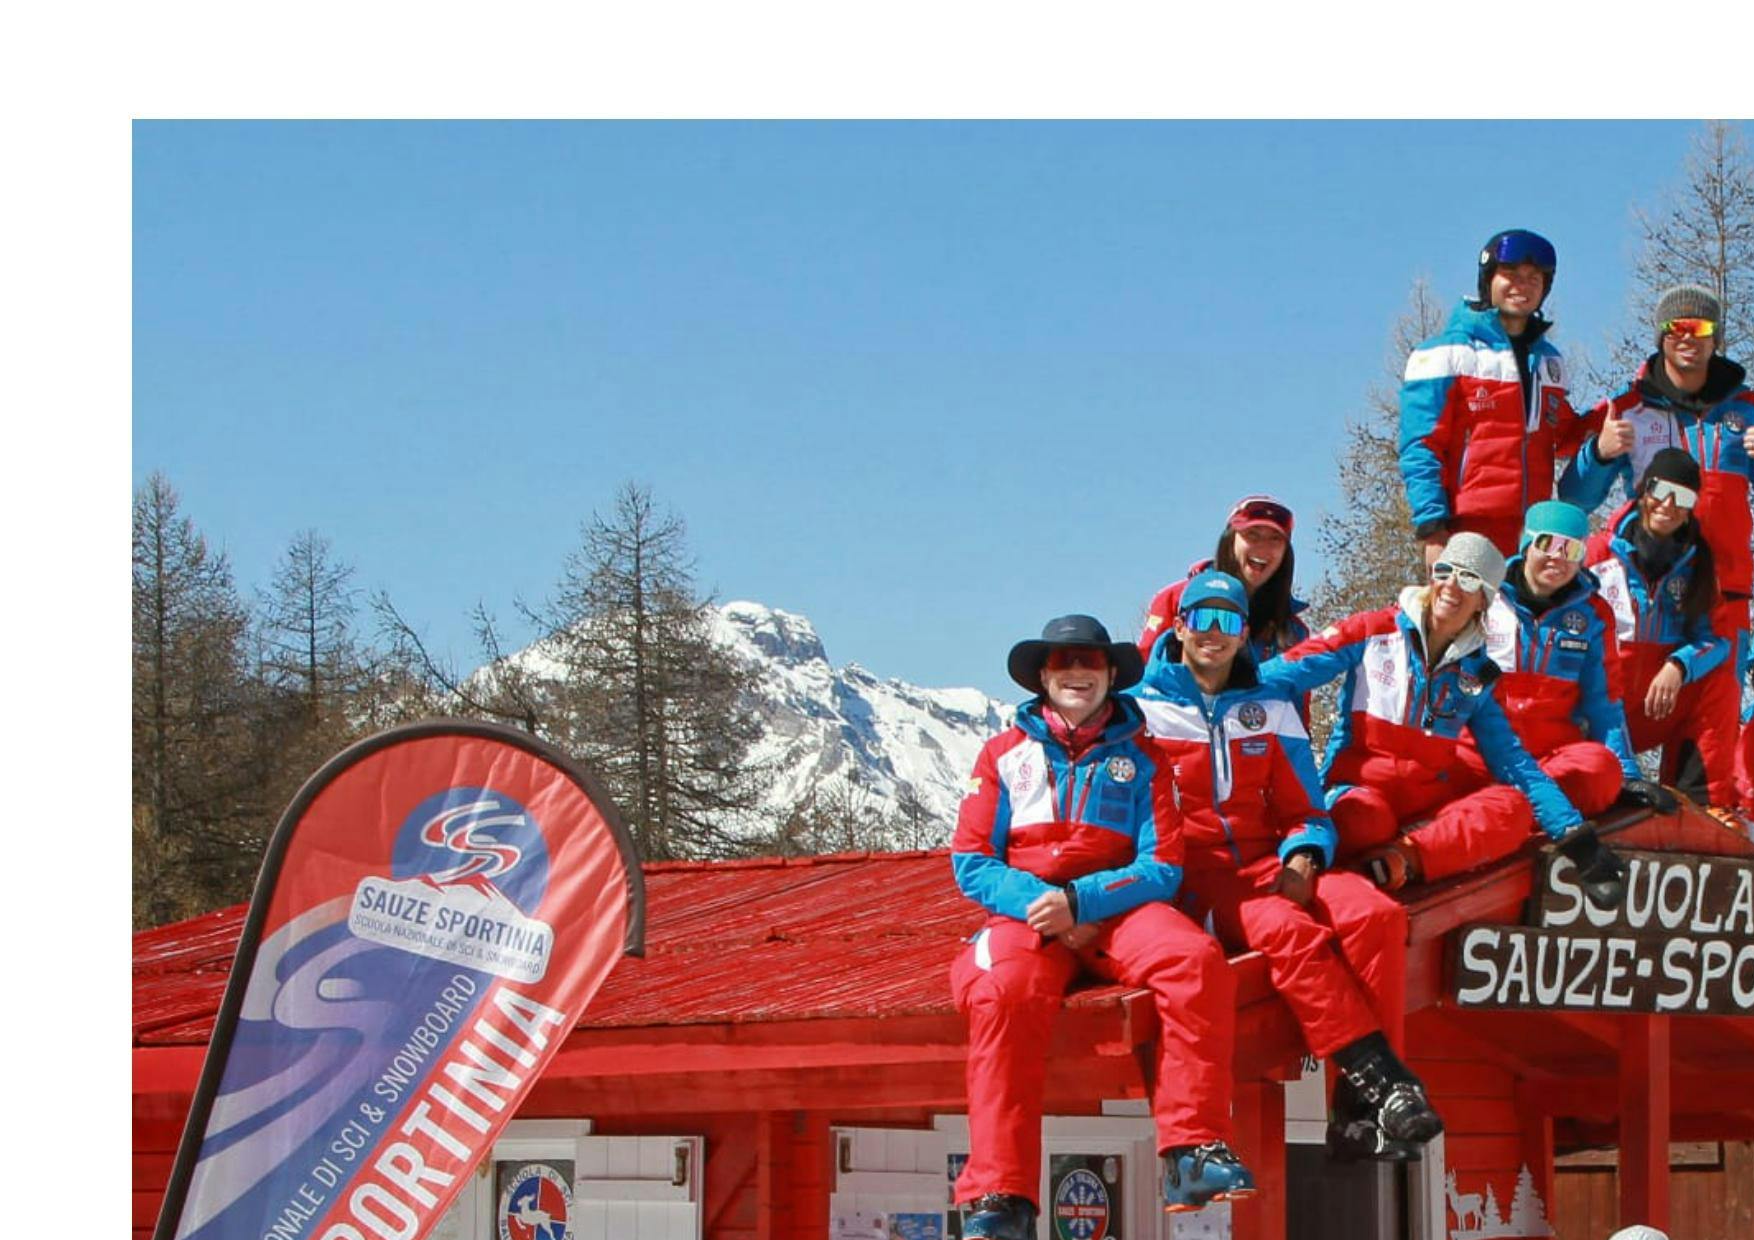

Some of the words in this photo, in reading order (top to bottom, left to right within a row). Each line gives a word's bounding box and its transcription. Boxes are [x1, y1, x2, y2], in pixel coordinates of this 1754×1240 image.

[360, 886, 430, 925] SAUZE
[435, 906, 545, 957] SPORTINIA
[375, 972, 478, 1106] SNOWBOARD
[370, 1101, 387, 1124] &
[334, 1124, 373, 1162] SCI
[314, 1160, 340, 1189] DI
